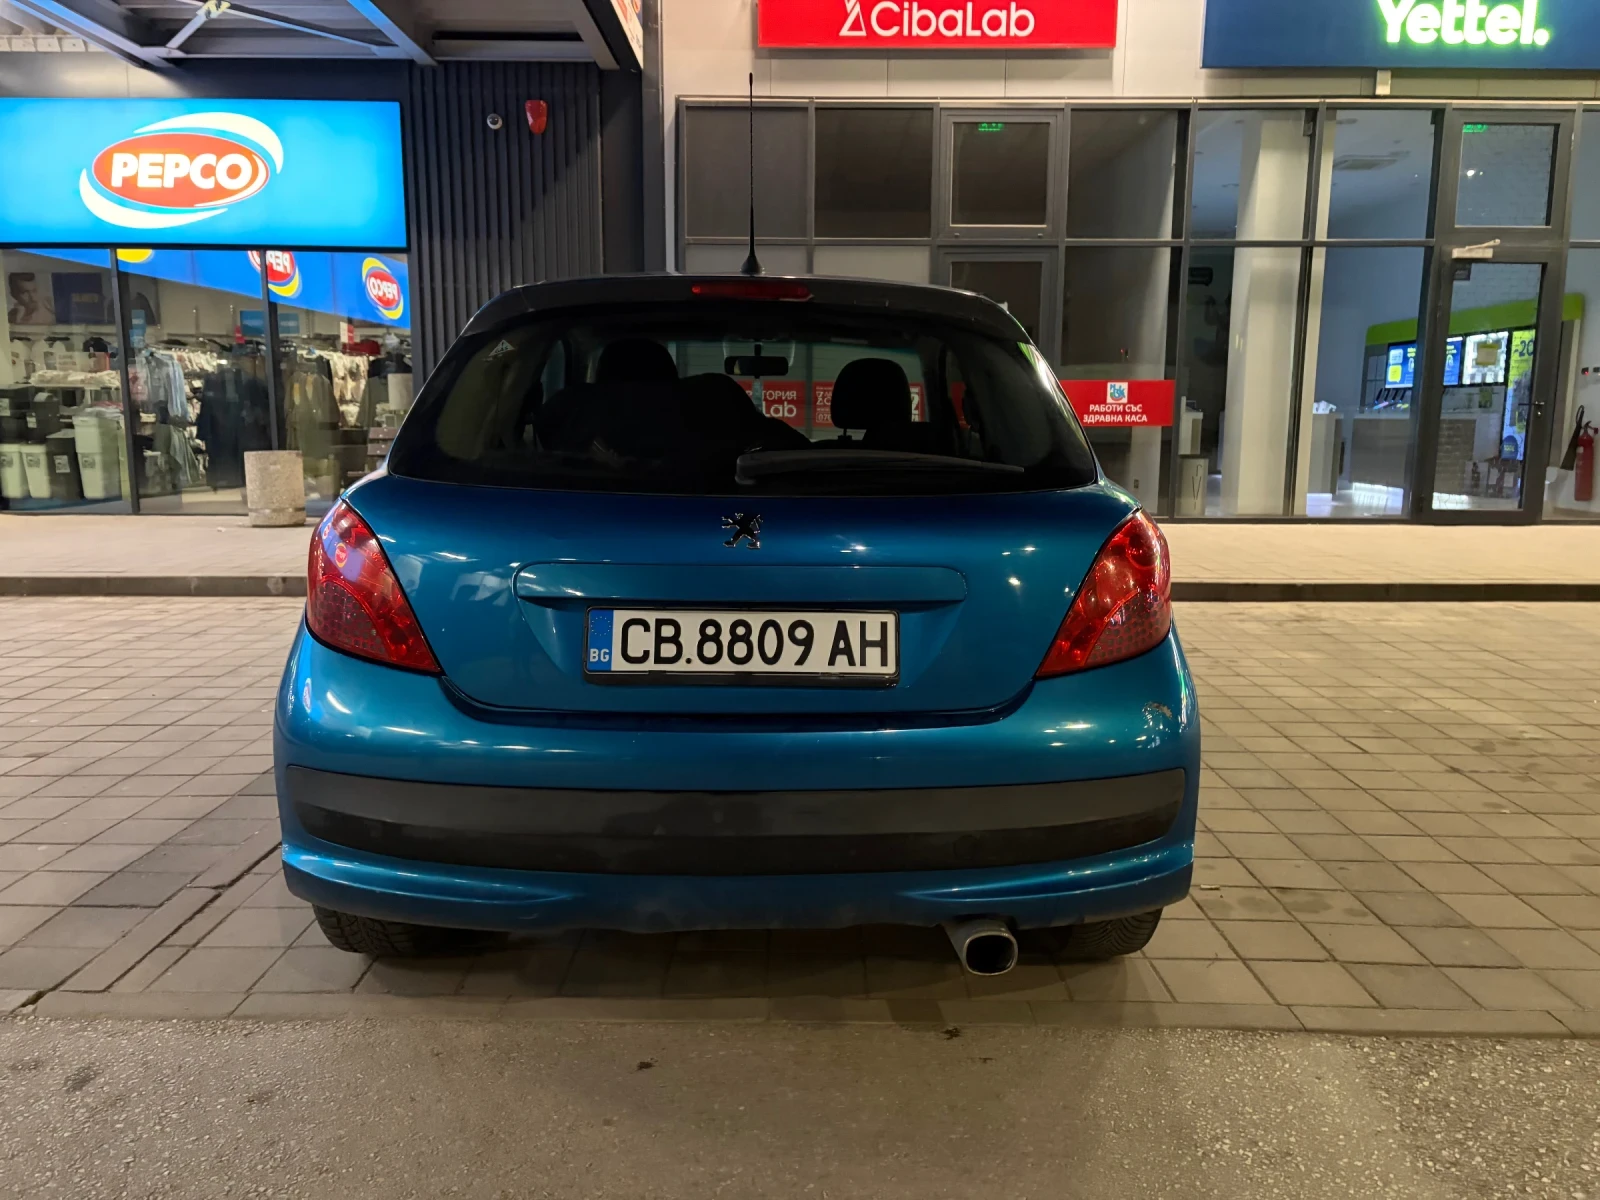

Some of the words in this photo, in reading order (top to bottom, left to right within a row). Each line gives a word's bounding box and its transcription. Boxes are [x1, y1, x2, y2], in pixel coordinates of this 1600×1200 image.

[870, 0, 1035, 37] CibaLab
[111, 152, 253, 190] PEPCO
[1083, 414, 1123, 424] ЗДРАВНА
[1125, 414, 1148, 423] КАСА
[1089, 404, 1124, 412] РАБОТИ
[1125, 404, 1143, 412] СЪС
[589, 648, 609, 662] BG
[827, 620, 889, 667] AH
